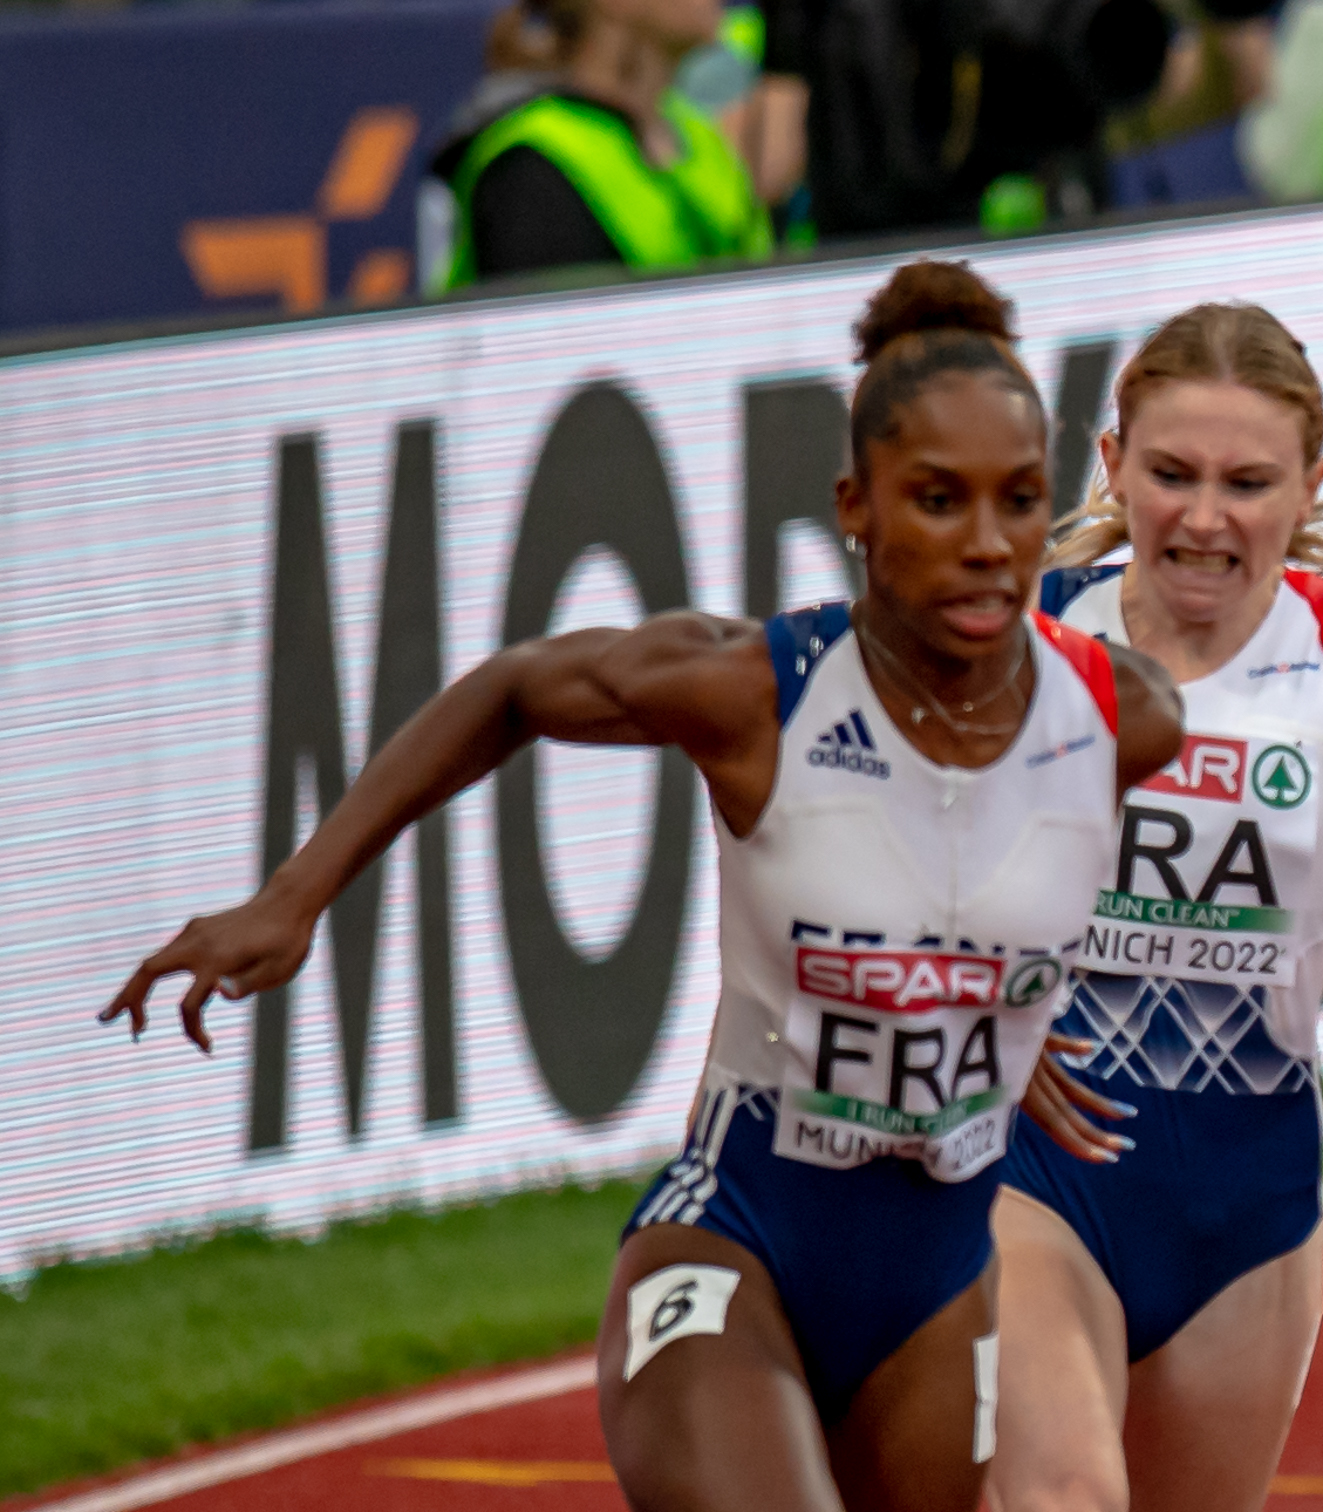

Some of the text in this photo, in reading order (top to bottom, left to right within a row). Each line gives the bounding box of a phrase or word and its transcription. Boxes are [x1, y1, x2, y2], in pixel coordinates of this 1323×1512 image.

[806, 747, 890, 780] adidas
[1117, 805, 1281, 908] RA
[1084, 925, 1173, 966] NICH
[1188, 939, 1281, 975] 2022
[802, 954, 997, 1007] SPAR
[815, 1011, 999, 1108] FRA
[649, 1278, 699, 1343] 6
